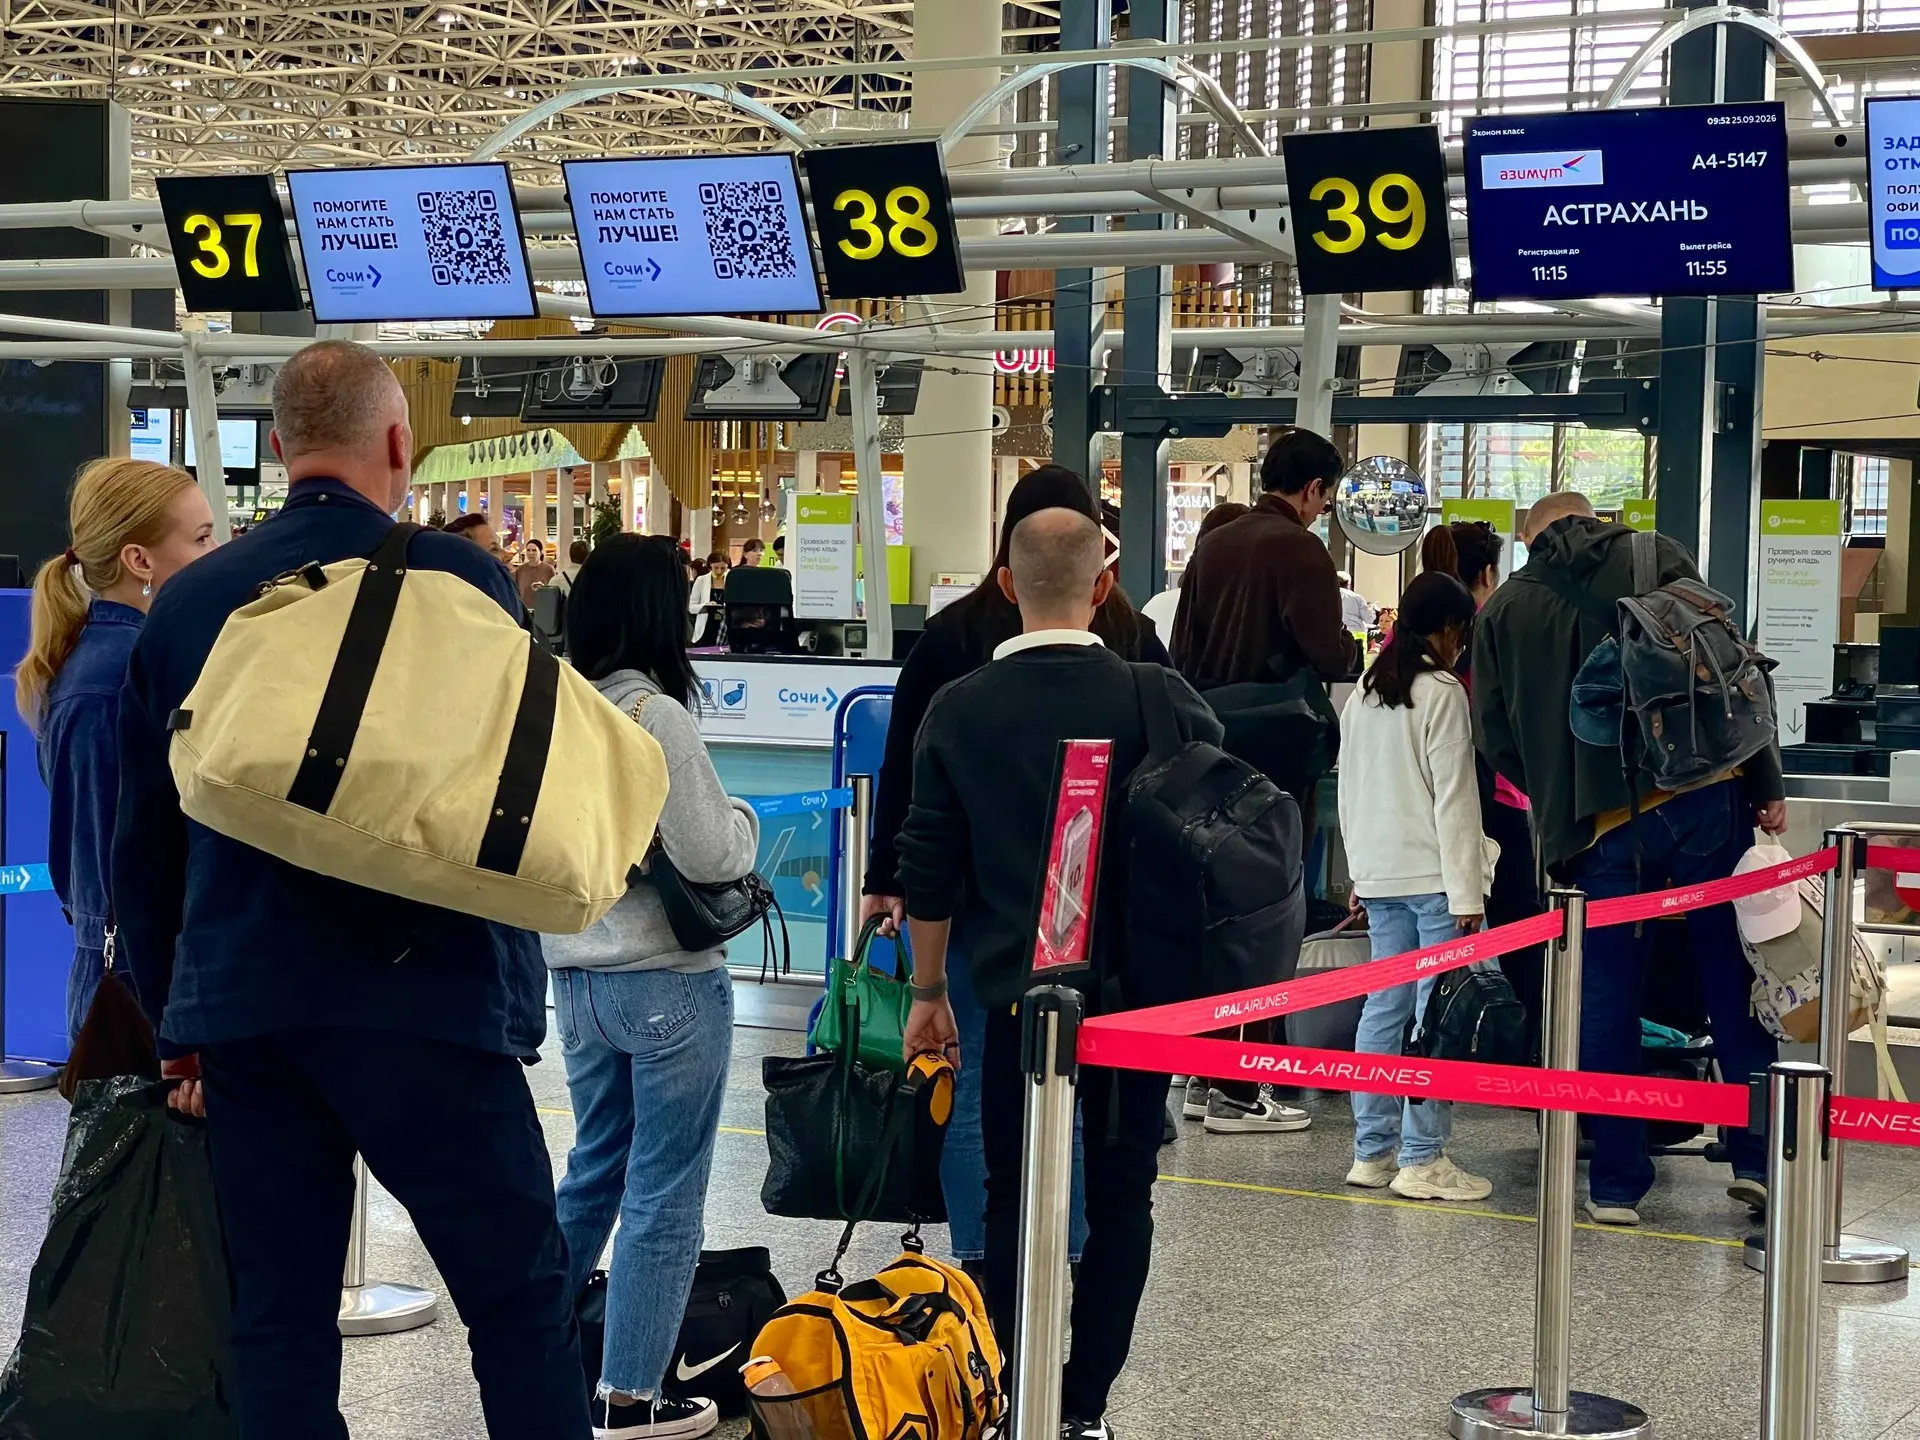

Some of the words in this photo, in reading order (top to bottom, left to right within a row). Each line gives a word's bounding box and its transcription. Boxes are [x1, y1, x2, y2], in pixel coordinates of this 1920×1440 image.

[1707, 117, 1731, 125] 09:52
[1731, 114, 1777, 124] 25.09.2026
[1472, 129, 1501, 137] Эконом
[1502, 128, 1525, 136] класс
[1692, 151, 1768, 170] A4-5147
[1500, 168, 1563, 181] азимут
[1887, 184, 1920, 195] ПОЛ
[590, 191, 668, 204] ПОМОГИТЕ
[313, 199, 388, 213] ПОМОГИТЕ
[1309, 173, 1426, 254] 39
[1543, 200, 1709, 226] АСТРАХАНЬ
[593, 208, 625, 221] НАМ
[629, 207, 675, 220] СТАТЬ
[316, 217, 348, 229] НАМ
[351, 215, 394, 228] СТАТЬ
[833, 186, 938, 260] 38
[321, 233, 399, 250] ЛУЧШЕ!
[598, 225, 679, 243] ЛУЧШЕ!
[1891, 227, 1920, 242] ПО
[184, 213, 262, 278] 37
[1518, 248, 1568, 256] Регистрация
[1569, 248, 1580, 256] до
[1680, 243, 1706, 251] Вылет
[1707, 242, 1732, 252] рейса
[604, 261, 643, 276] Сочи
[1532, 265, 1568, 281] 11:15
[1686, 260, 1728, 276] 11:55
[327, 269, 364, 283] Сочи
[778, 688, 819, 704] Сочи
[802, 796, 820, 807] Сочи
[1416, 955, 1438, 970] URAL
[1438, 943, 1475, 964] AIRLINES
[1214, 1002, 1242, 1019] URAL
[1242, 992, 1289, 1013] AIRLINES
[1239, 1054, 1308, 1074] URAL
[1308, 1062, 1433, 1086] AIRLINES
